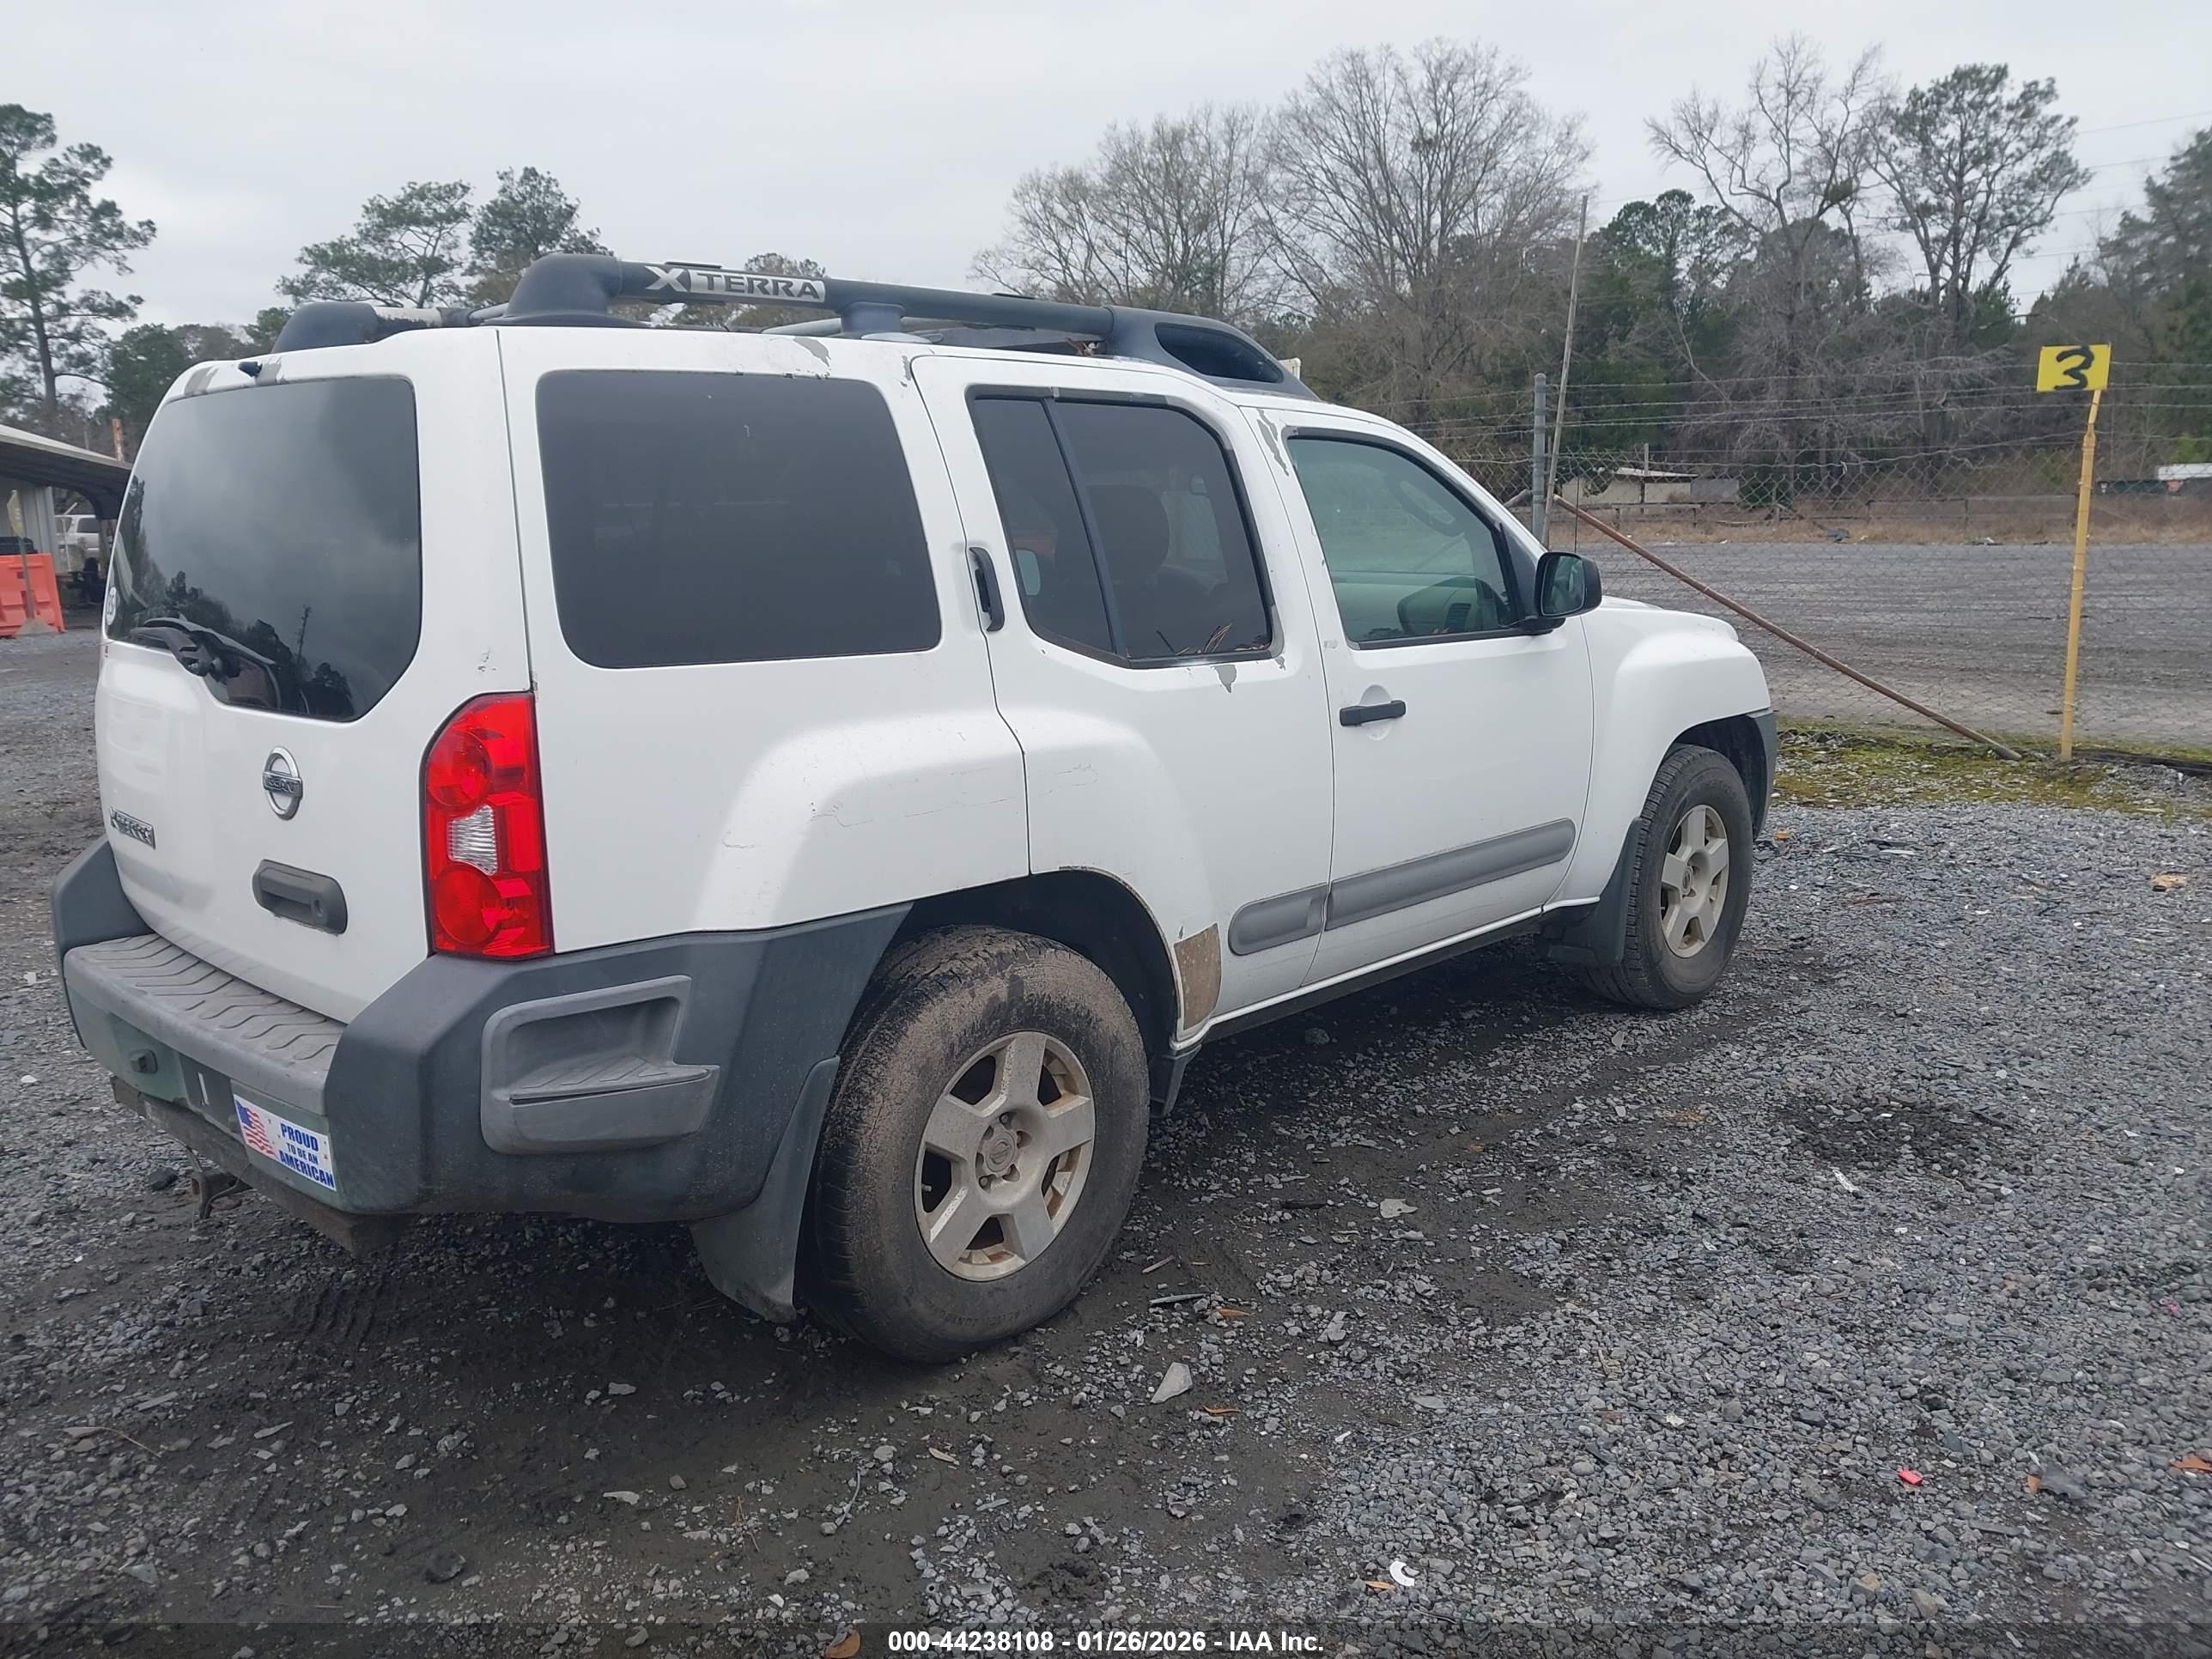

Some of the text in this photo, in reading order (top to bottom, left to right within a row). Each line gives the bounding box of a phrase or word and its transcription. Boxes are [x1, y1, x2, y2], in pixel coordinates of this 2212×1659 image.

[645, 265, 821, 300] XTERRA
[2054, 346, 2094, 390] 3
[280, 1122, 319, 1152] PROUD
[286, 1142, 319, 1165] TO BE AN
[278, 1150, 335, 1188] AMERICAN
